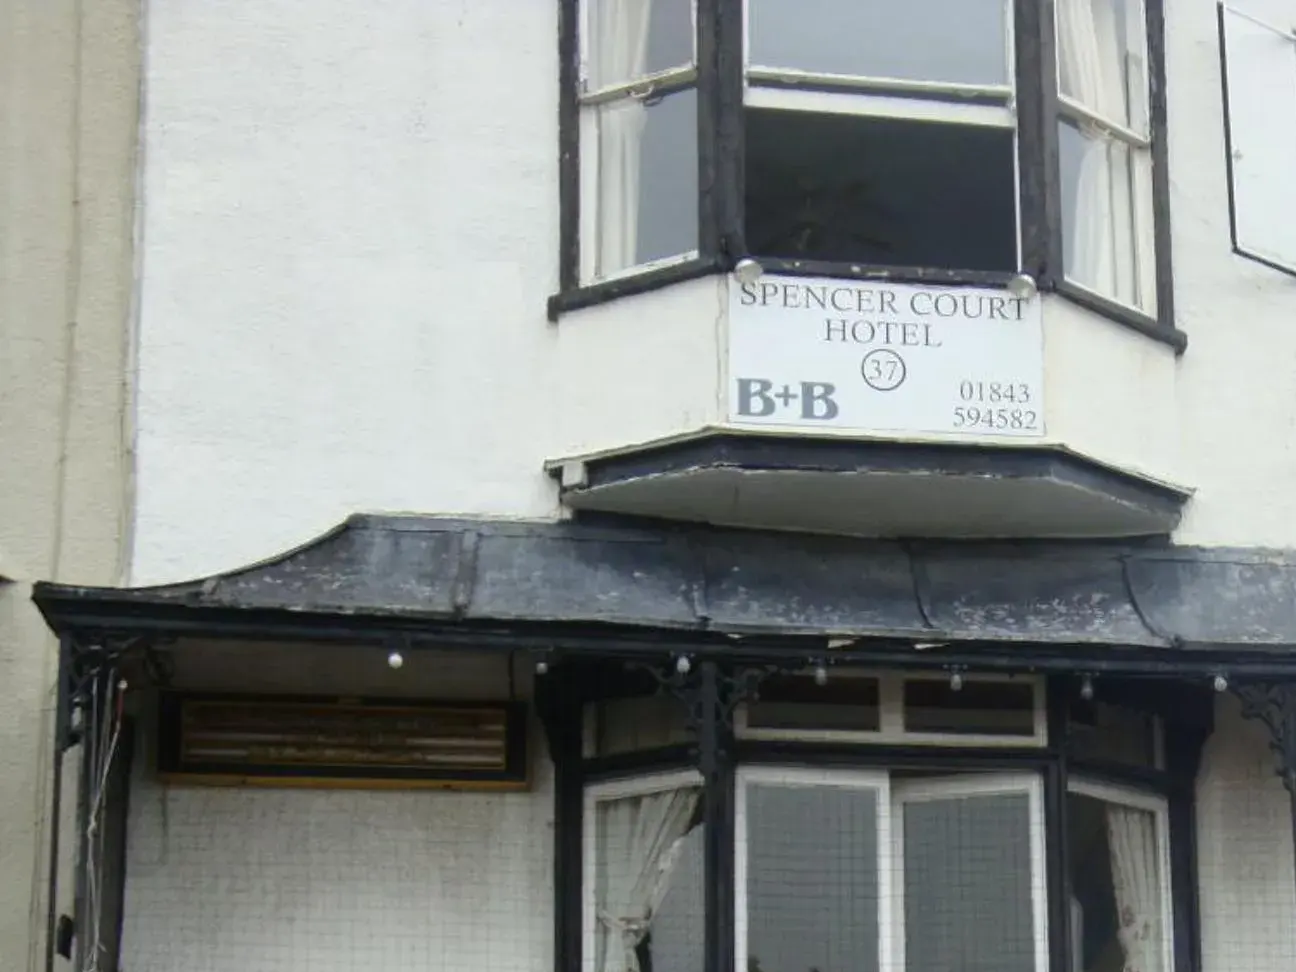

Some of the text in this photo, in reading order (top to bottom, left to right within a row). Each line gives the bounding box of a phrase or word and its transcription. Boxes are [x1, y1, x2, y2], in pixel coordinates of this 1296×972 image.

[740, 282, 1029, 320] SPENCER COURT
[825, 319, 942, 347] HOTEL
[868, 358, 898, 381] 37
[736, 377, 840, 421] B+B
[959, 381, 1031, 404] 01843
[952, 406, 1038, 430] 594582
